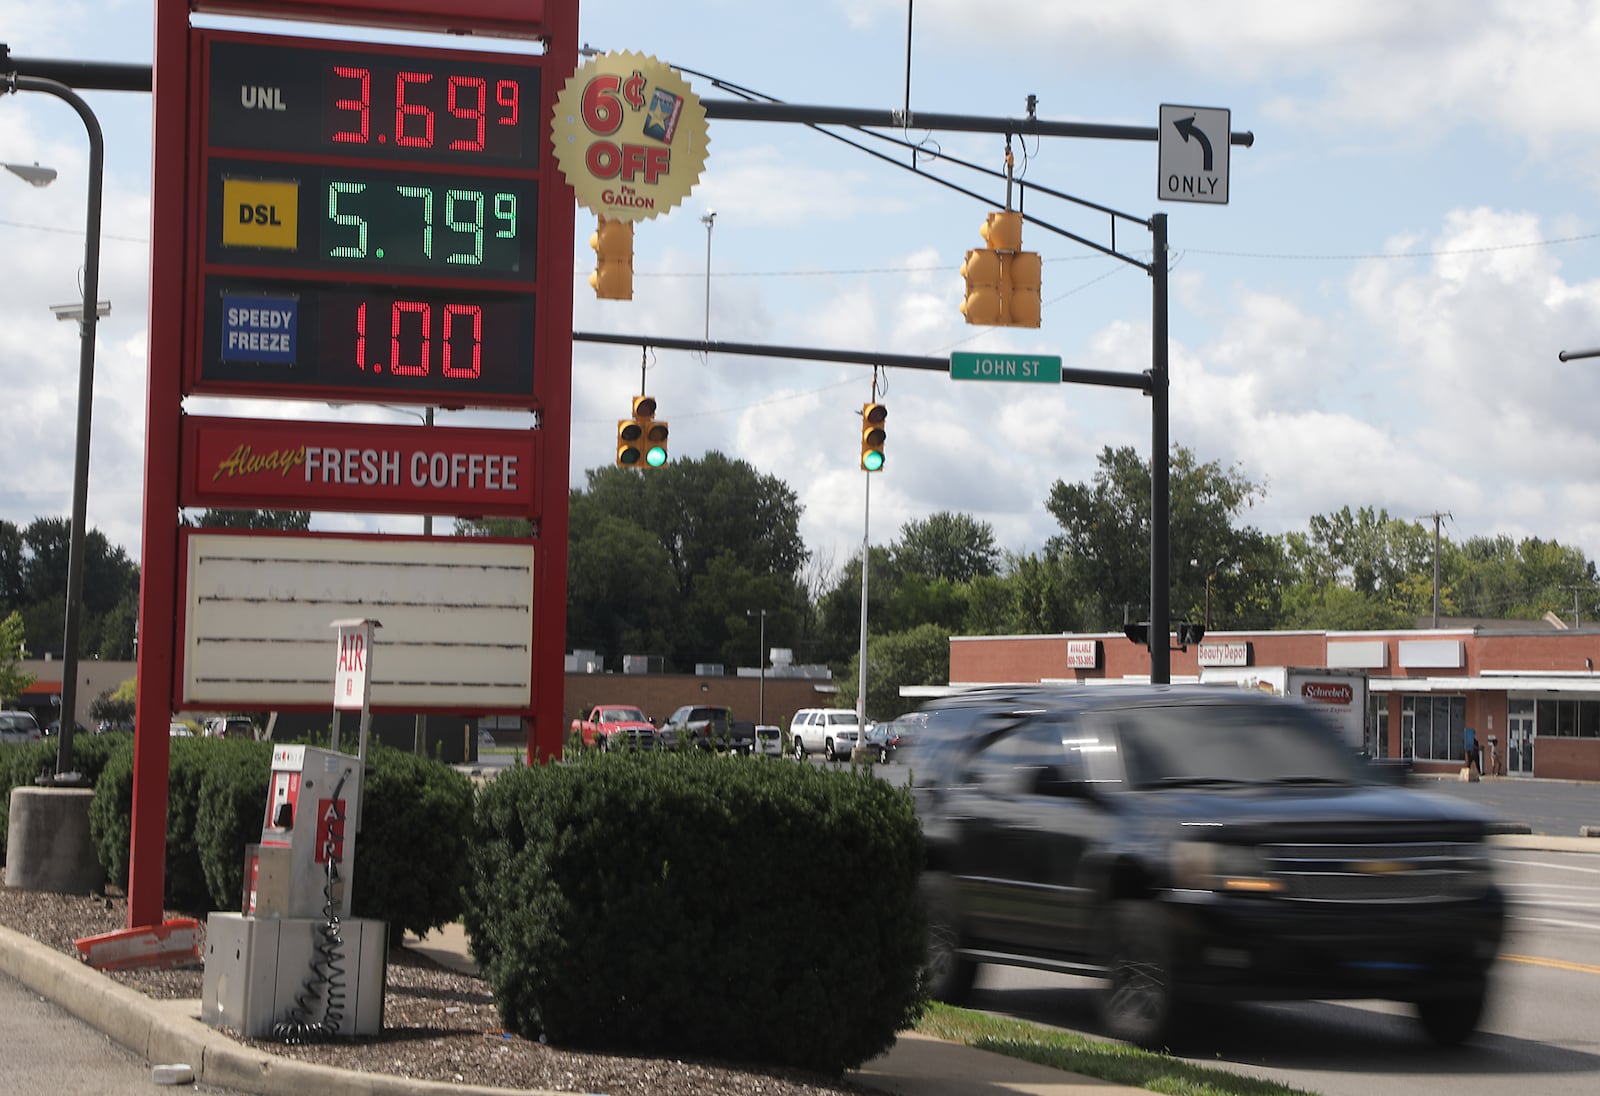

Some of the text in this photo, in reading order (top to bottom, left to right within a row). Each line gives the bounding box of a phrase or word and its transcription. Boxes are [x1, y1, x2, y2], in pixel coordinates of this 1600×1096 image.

[241, 85, 287, 111] UNL
[585, 140, 672, 184] OFF
[1168, 174, 1219, 194] ONLY
[238, 203, 282, 227] DSL
[227, 307, 292, 330] SPEEDY
[228, 331, 290, 353] FREEZE
[355, 300, 482, 380] 1.00
[973, 358, 1041, 377] JOHN ST
[212, 443, 519, 491] Always FRESH COFFEE
[338, 633, 364, 673] AIR
[1199, 643, 1246, 664] Beauty Depot
